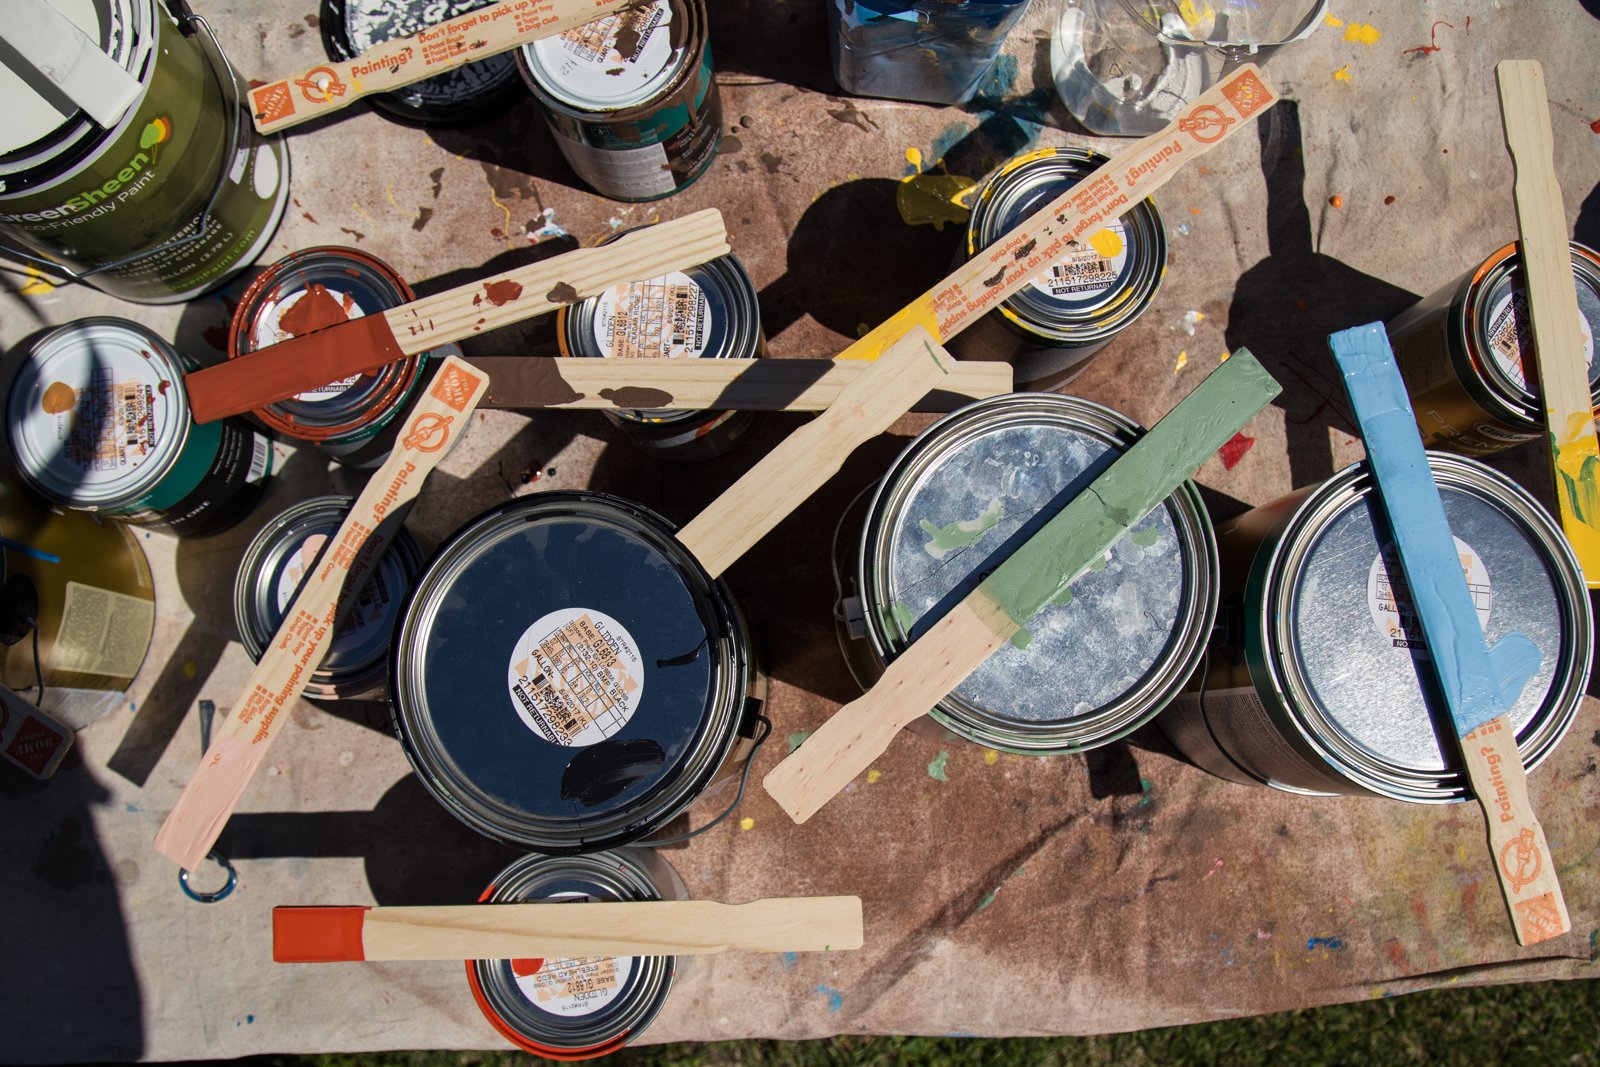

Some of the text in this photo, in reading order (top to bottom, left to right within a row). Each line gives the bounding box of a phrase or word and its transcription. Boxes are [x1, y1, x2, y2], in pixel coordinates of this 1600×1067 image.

[417, 28, 444, 43] Don't
[446, 18, 477, 32] forget
[479, 14, 489, 22] to
[491, 4, 512, 21] pick
[428, 41, 445, 51] Paint
[445, 35, 464, 44] Brush
[431, 48, 447, 56] Paint
[631, 46, 642, 60] NOT
[350, 47, 414, 78] Painting?
[260, 92, 270, 104] THE
[1124, 139, 1183, 187] Painting?
[118, 170, 156, 202] Paint
[1054, 179, 1105, 215] Paint Roller Cover
[1076, 184, 1108, 208] Paint Roller
[1079, 189, 1113, 214] Paint Brush
[1101, 193, 1128, 215] Don't
[1073, 212, 1103, 237] forget
[991, 239, 1019, 261] Drop Cloth
[1041, 238, 1062, 259] pick
[1063, 234, 1073, 244] to
[1005, 263, 1028, 285] your
[1027, 256, 1040, 267] up
[1047, 270, 1117, 287] 211517298225
[965, 281, 1005, 312] painting
[616, 311, 627, 336] GL6812
[684, 282, 698, 352] 211517298227
[605, 314, 615, 347] GLIDDEN
[630, 317, 638, 344] CEADAR
[442, 377, 453, 400] DEPOT
[447, 370, 464, 404] HOME
[461, 378, 469, 392] THE
[372, 460, 416, 523] Painting?
[341, 526, 355, 544] Paint
[336, 530, 361, 567] Paint Roller
[319, 561, 335, 582] Cover
[320, 601, 342, 627] pick
[280, 616, 301, 649] Drop Cloth
[292, 625, 315, 656] Paint Tray
[311, 624, 327, 642] up
[578, 620, 617, 667] BASE: GL6813
[593, 620, 622, 655] GLIDDEN
[301, 640, 317, 666] your
[582, 638, 595, 654] Prem
[592, 652, 601, 662] Ext
[275, 664, 303, 705] painting
[531, 648, 590, 730] GALLON- (KL)
[575, 641, 599, 672] (2132-10)
[596, 670, 610, 687] BMP
[609, 688, 629, 713] BLACK
[246, 691, 258, 708] Paint
[257, 698, 271, 713] Rags
[514, 688, 528, 704] NOT
[243, 706, 258, 723] Sticks
[517, 674, 573, 747] 211517298233
[1479, 746, 1514, 824] Painting?
[536, 972, 556, 982] REDD
[557, 964, 598, 977] STEELHEAD
[573, 987, 607, 1001] GLIDDEN
